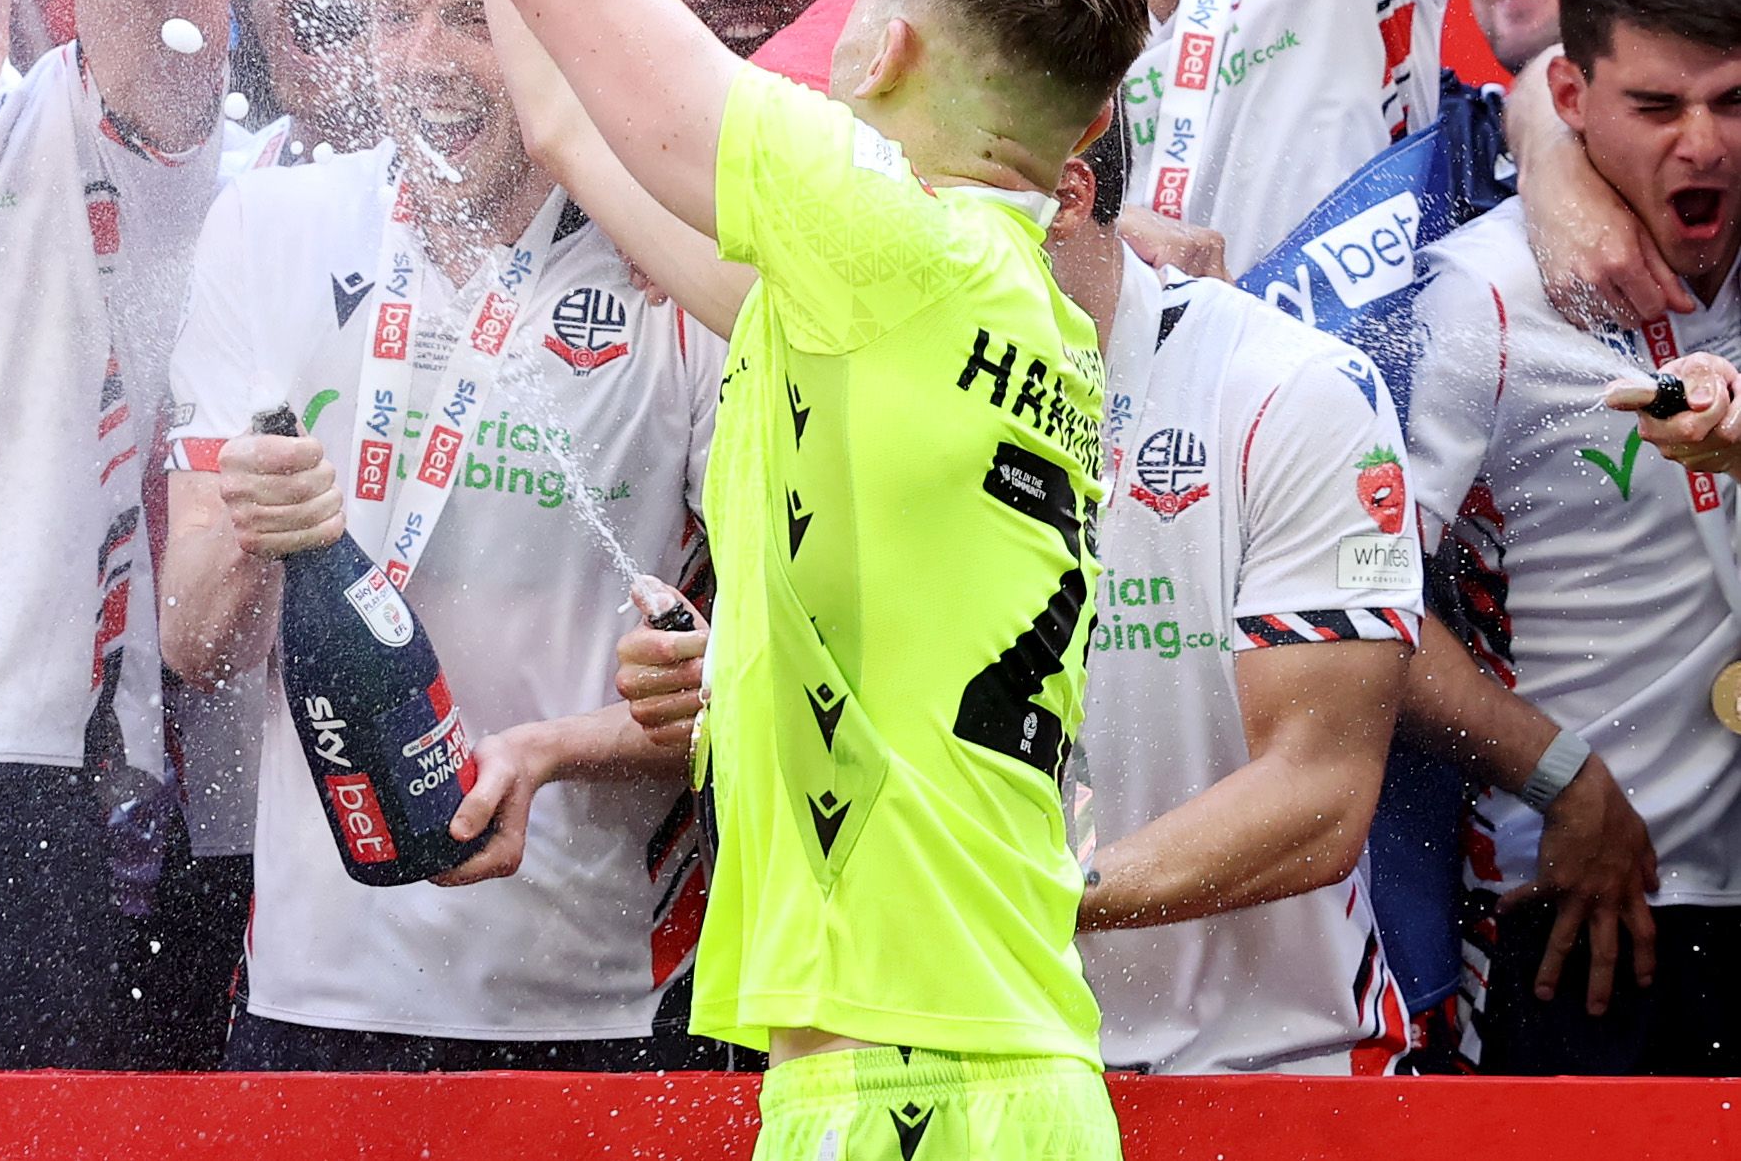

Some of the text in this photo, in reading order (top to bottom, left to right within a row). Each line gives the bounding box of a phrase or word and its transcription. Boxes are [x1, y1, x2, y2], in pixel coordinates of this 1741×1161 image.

[1180, 37, 1213, 86] bet
[1165, 117, 1195, 163] sky
[1157, 172, 1189, 220] bet
[498, 248, 533, 293] sky
[1322, 212, 1419, 285] bet
[385, 251, 414, 299] sky
[378, 306, 412, 358] bet
[365, 389, 397, 438] sky
[442, 379, 476, 427] sky
[359, 444, 392, 498] bet
[420, 431, 461, 483] bet
[1011, 476, 1047, 501] COMMUNITY
[1031, 475, 1044, 489] THE
[394, 512, 422, 560] sky
[354, 584, 372, 601] sky
[393, 623, 408, 637] EFL
[416, 745, 446, 773] WE
[1019, 738, 1033, 754] EFL
[305, 696, 385, 855] sky bet
[408, 751, 464, 797] GOING
